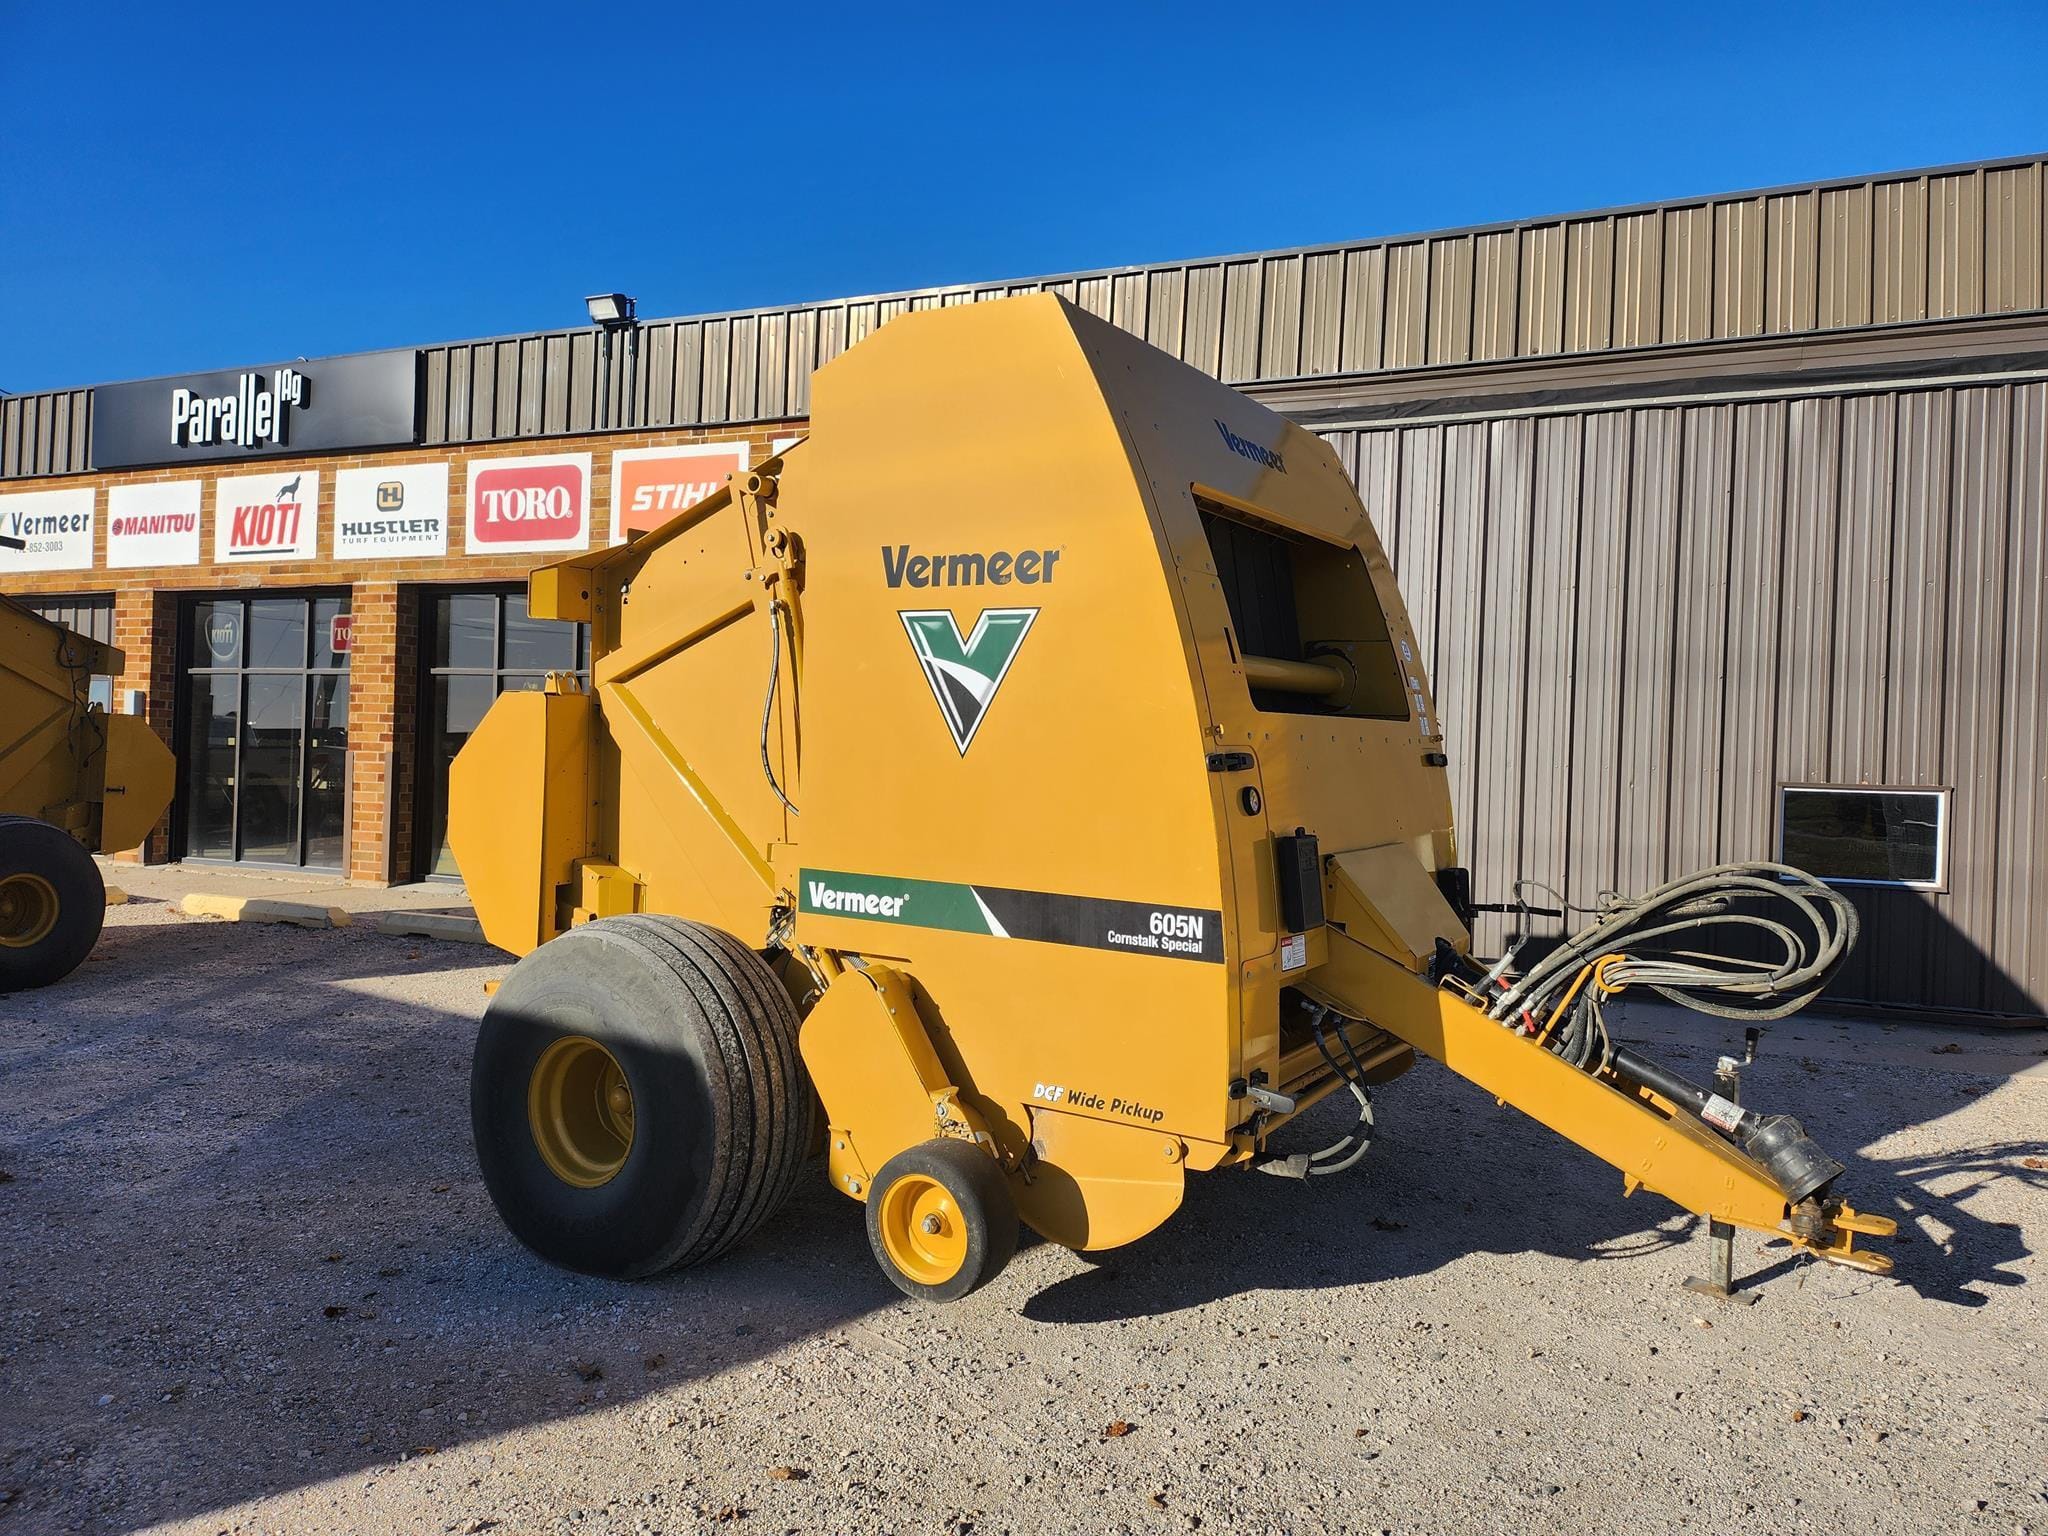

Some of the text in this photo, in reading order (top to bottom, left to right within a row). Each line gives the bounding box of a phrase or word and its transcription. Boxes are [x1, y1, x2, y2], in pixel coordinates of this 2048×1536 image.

[171, 368, 302, 446] Parallel Ag
[1212, 418, 1287, 475] Vermeer
[481, 485, 569, 523] TORO
[12, 512, 89, 536] Vermeer
[124, 513, 195, 535] MANITOU
[230, 503, 302, 547] KIOTI
[341, 519, 439, 536] HUSTLER
[342, 534, 440, 545] TURF EQUIPMENT
[881, 544, 1060, 588] Vermeer
[211, 628, 233, 644] KIOTI
[808, 880, 904, 918] Vermeer
[1149, 912, 1203, 939] 605N
[1107, 930, 1203, 954] Cornstalk Special
[1033, 1083, 1164, 1123] DCF Wide Pickup
